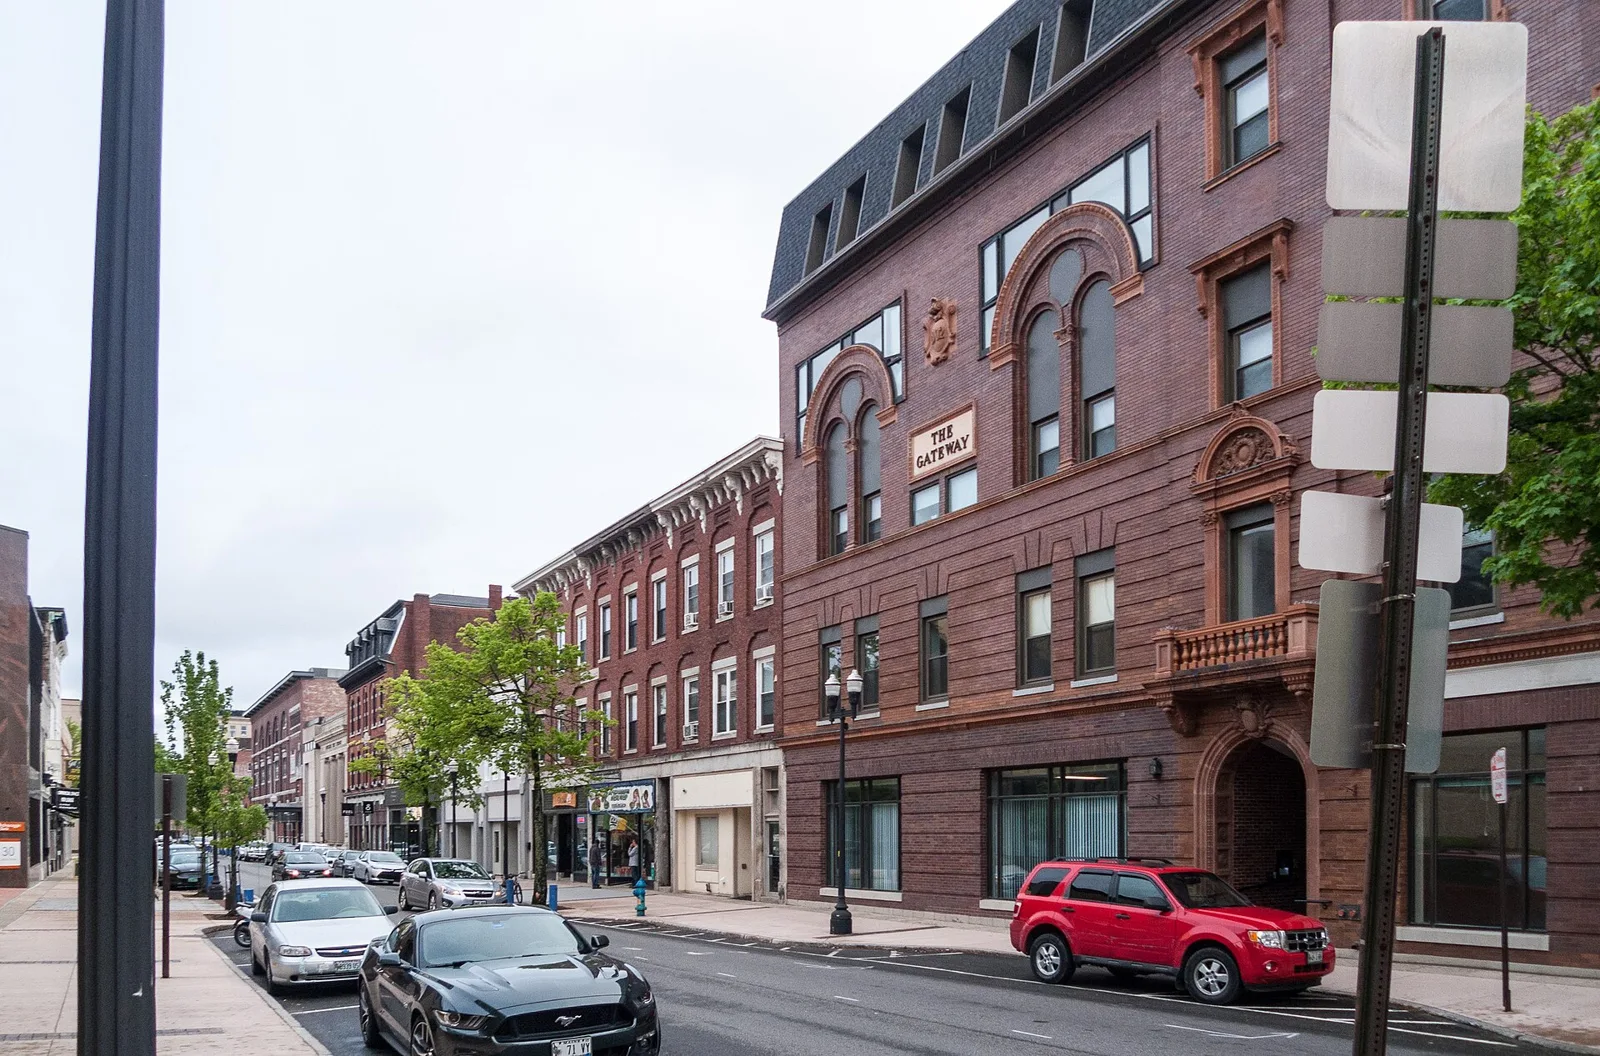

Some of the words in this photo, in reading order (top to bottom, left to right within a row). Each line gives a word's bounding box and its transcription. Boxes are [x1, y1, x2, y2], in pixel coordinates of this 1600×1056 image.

[931, 424, 953, 446] THE
[916, 434, 970, 469] GATEWAY
[2, 846, 15, 857] 30
[566, 1044, 576, 1055] 71
